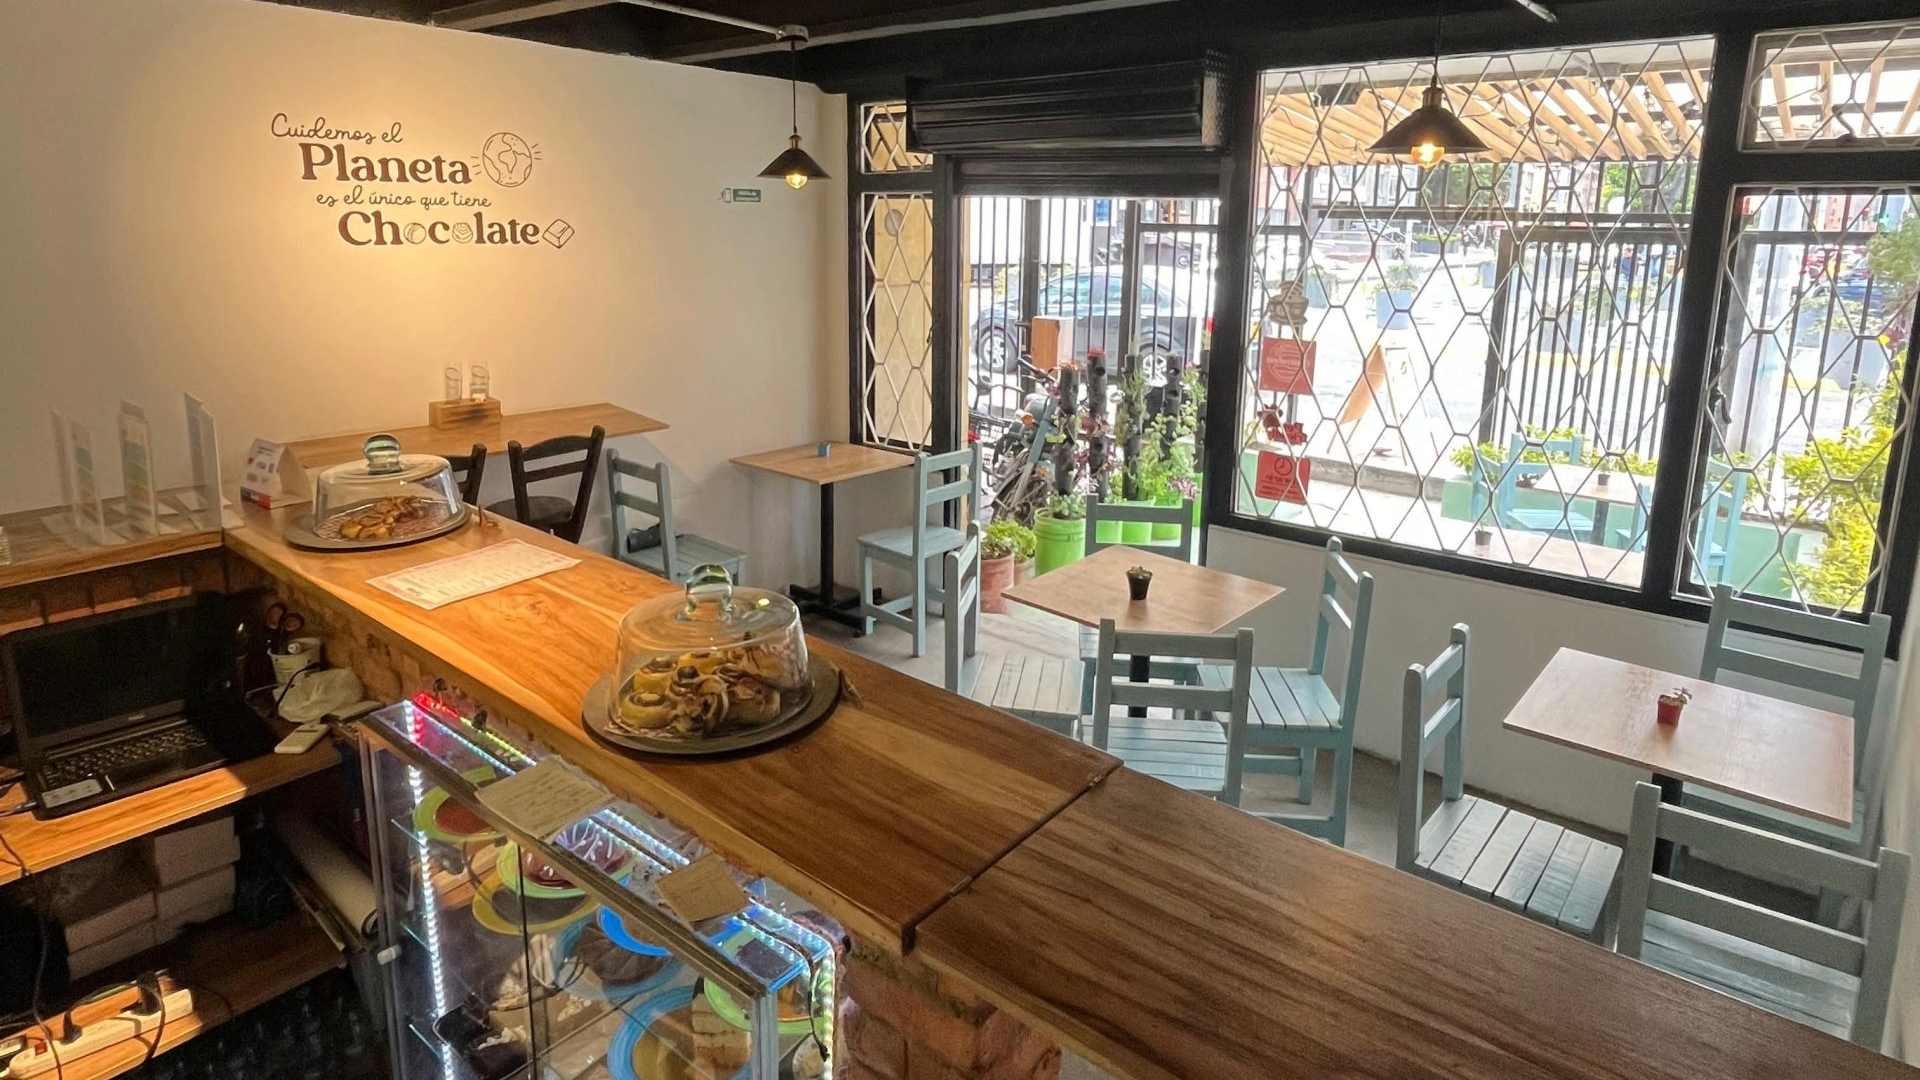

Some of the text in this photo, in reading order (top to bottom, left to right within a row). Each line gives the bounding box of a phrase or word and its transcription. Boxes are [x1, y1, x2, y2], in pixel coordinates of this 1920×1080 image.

[271, 113, 403, 145] Cuidemos el
[298, 142, 472, 184] Planeta
[316, 185, 492, 210] es el único que tiene
